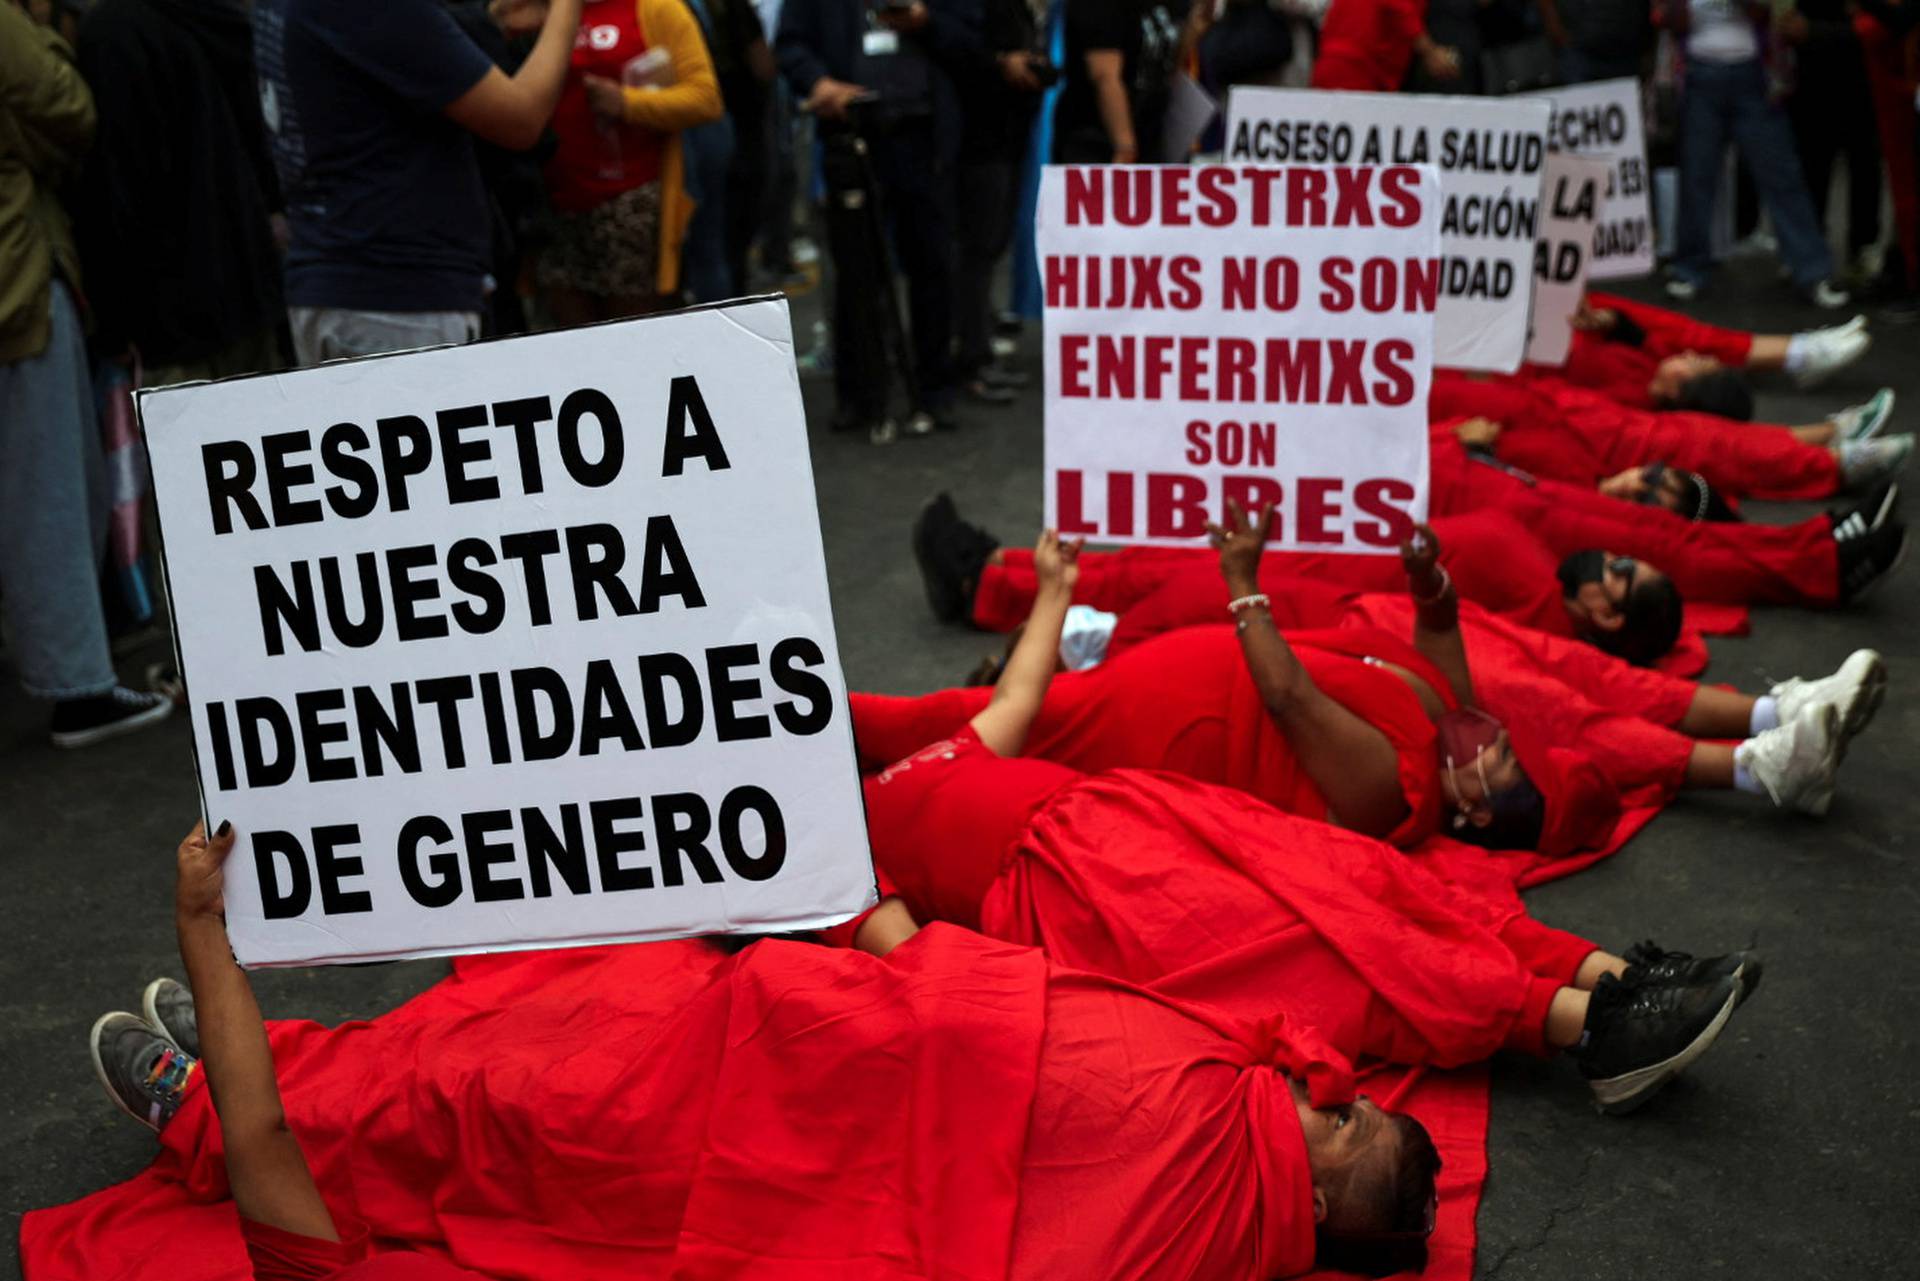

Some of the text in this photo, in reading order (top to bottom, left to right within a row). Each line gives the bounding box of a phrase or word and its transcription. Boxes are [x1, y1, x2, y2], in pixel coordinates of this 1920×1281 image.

[1231, 119, 1542, 175] ACSESO A LA SALUD
[1066, 165, 1421, 228] NUESTRXS
[1552, 175, 1596, 222] LA
[1045, 255, 1438, 313] HIJXS NO SON
[1060, 335, 1414, 406] ENFERMXS
[201, 375, 731, 535] RESPETO A
[1186, 420, 1276, 467] SON
[1056, 470, 1415, 547] LIBRES
[254, 515, 707, 656] NUESTRA
[206, 637, 833, 791] IDENTIDADES
[251, 785, 786, 920] DE GENERO
